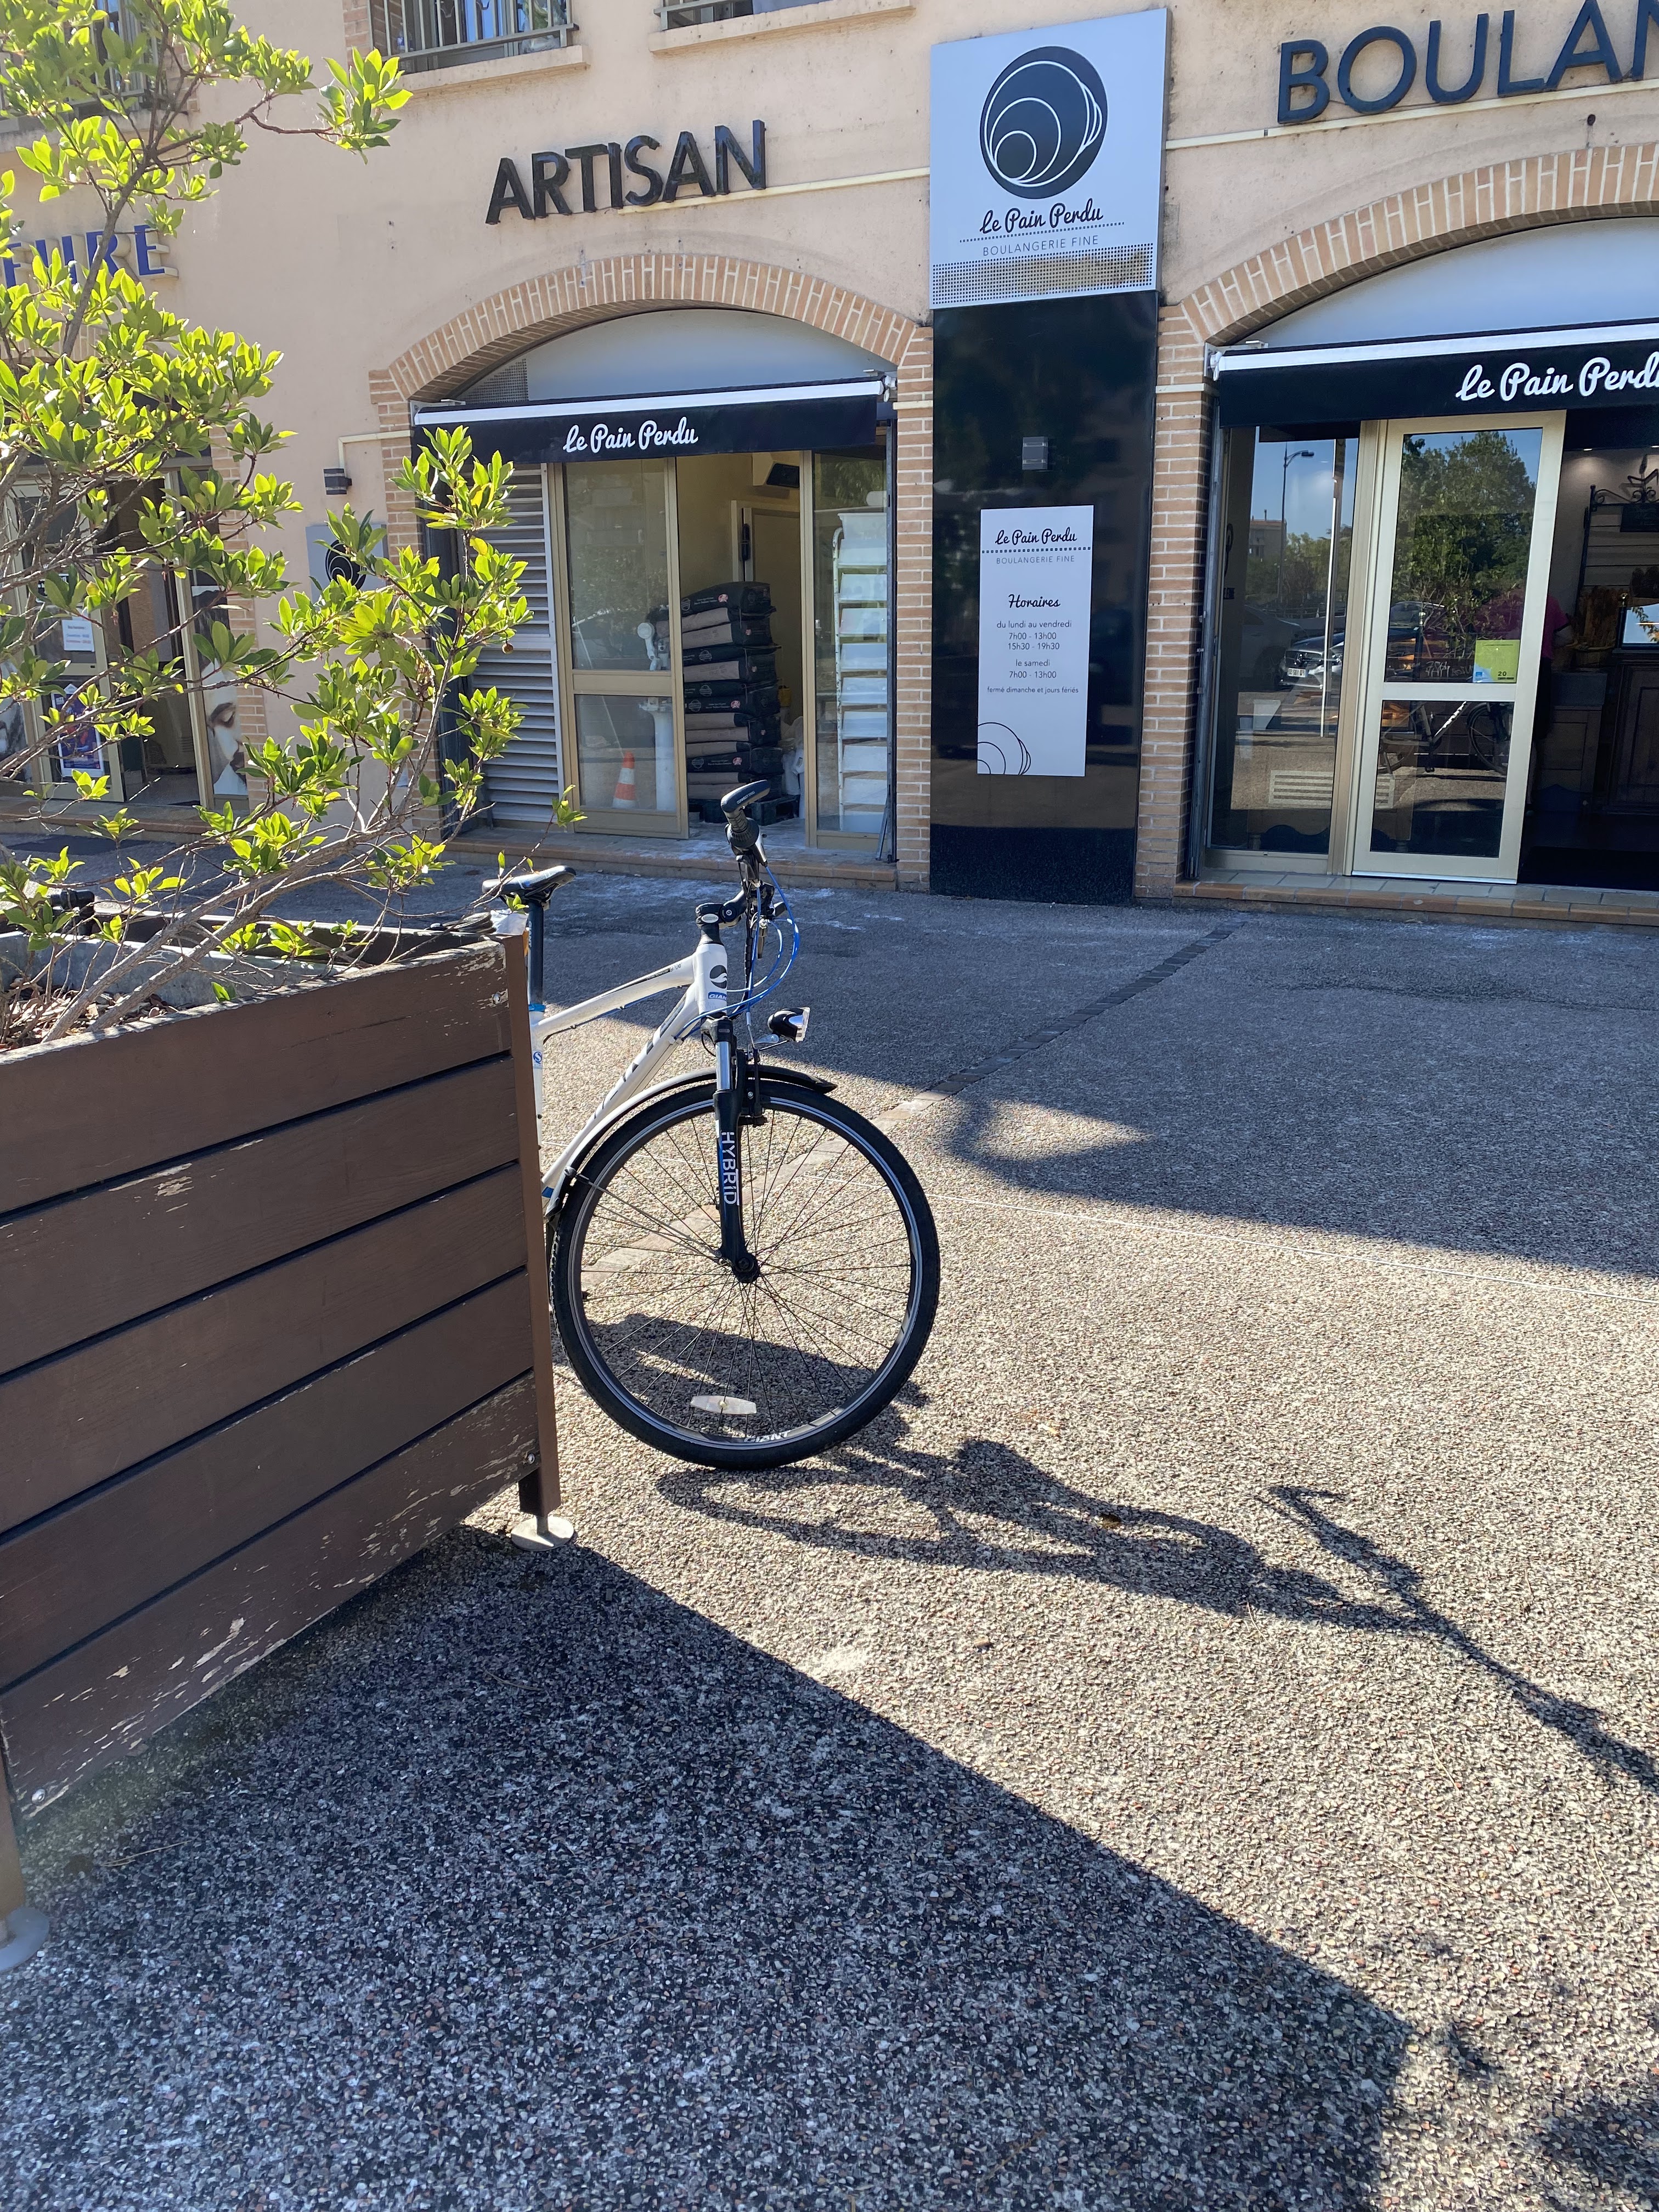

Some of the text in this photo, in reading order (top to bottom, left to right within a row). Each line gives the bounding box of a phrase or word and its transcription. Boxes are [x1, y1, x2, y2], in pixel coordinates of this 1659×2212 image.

[485, 119, 766, 225] ARTISAN
[1005, 208, 1046, 233] Pain
[1049, 198, 1104, 228] Perdu
[983, 235, 1099, 256] BOULANGERIE FINE
[1499, 362, 1574, 401] Pain
[1579, 351, 1659, 397] Perd
[590, 423, 636, 454] Pain
[638, 416, 699, 450] Perdu
[1012, 529, 1040, 545] Pain
[1041, 527, 1077, 544] Perdu
[996, 556, 1053, 565] BOULANGERIE
[1008, 594, 1061, 608] Horaires
[1008, 620, 1026, 628] lundi
[1039, 620, 1072, 628] vendredi
[721, 1132, 737, 1205] HYBRID
[744, 1430, 791, 1442] GIANT
